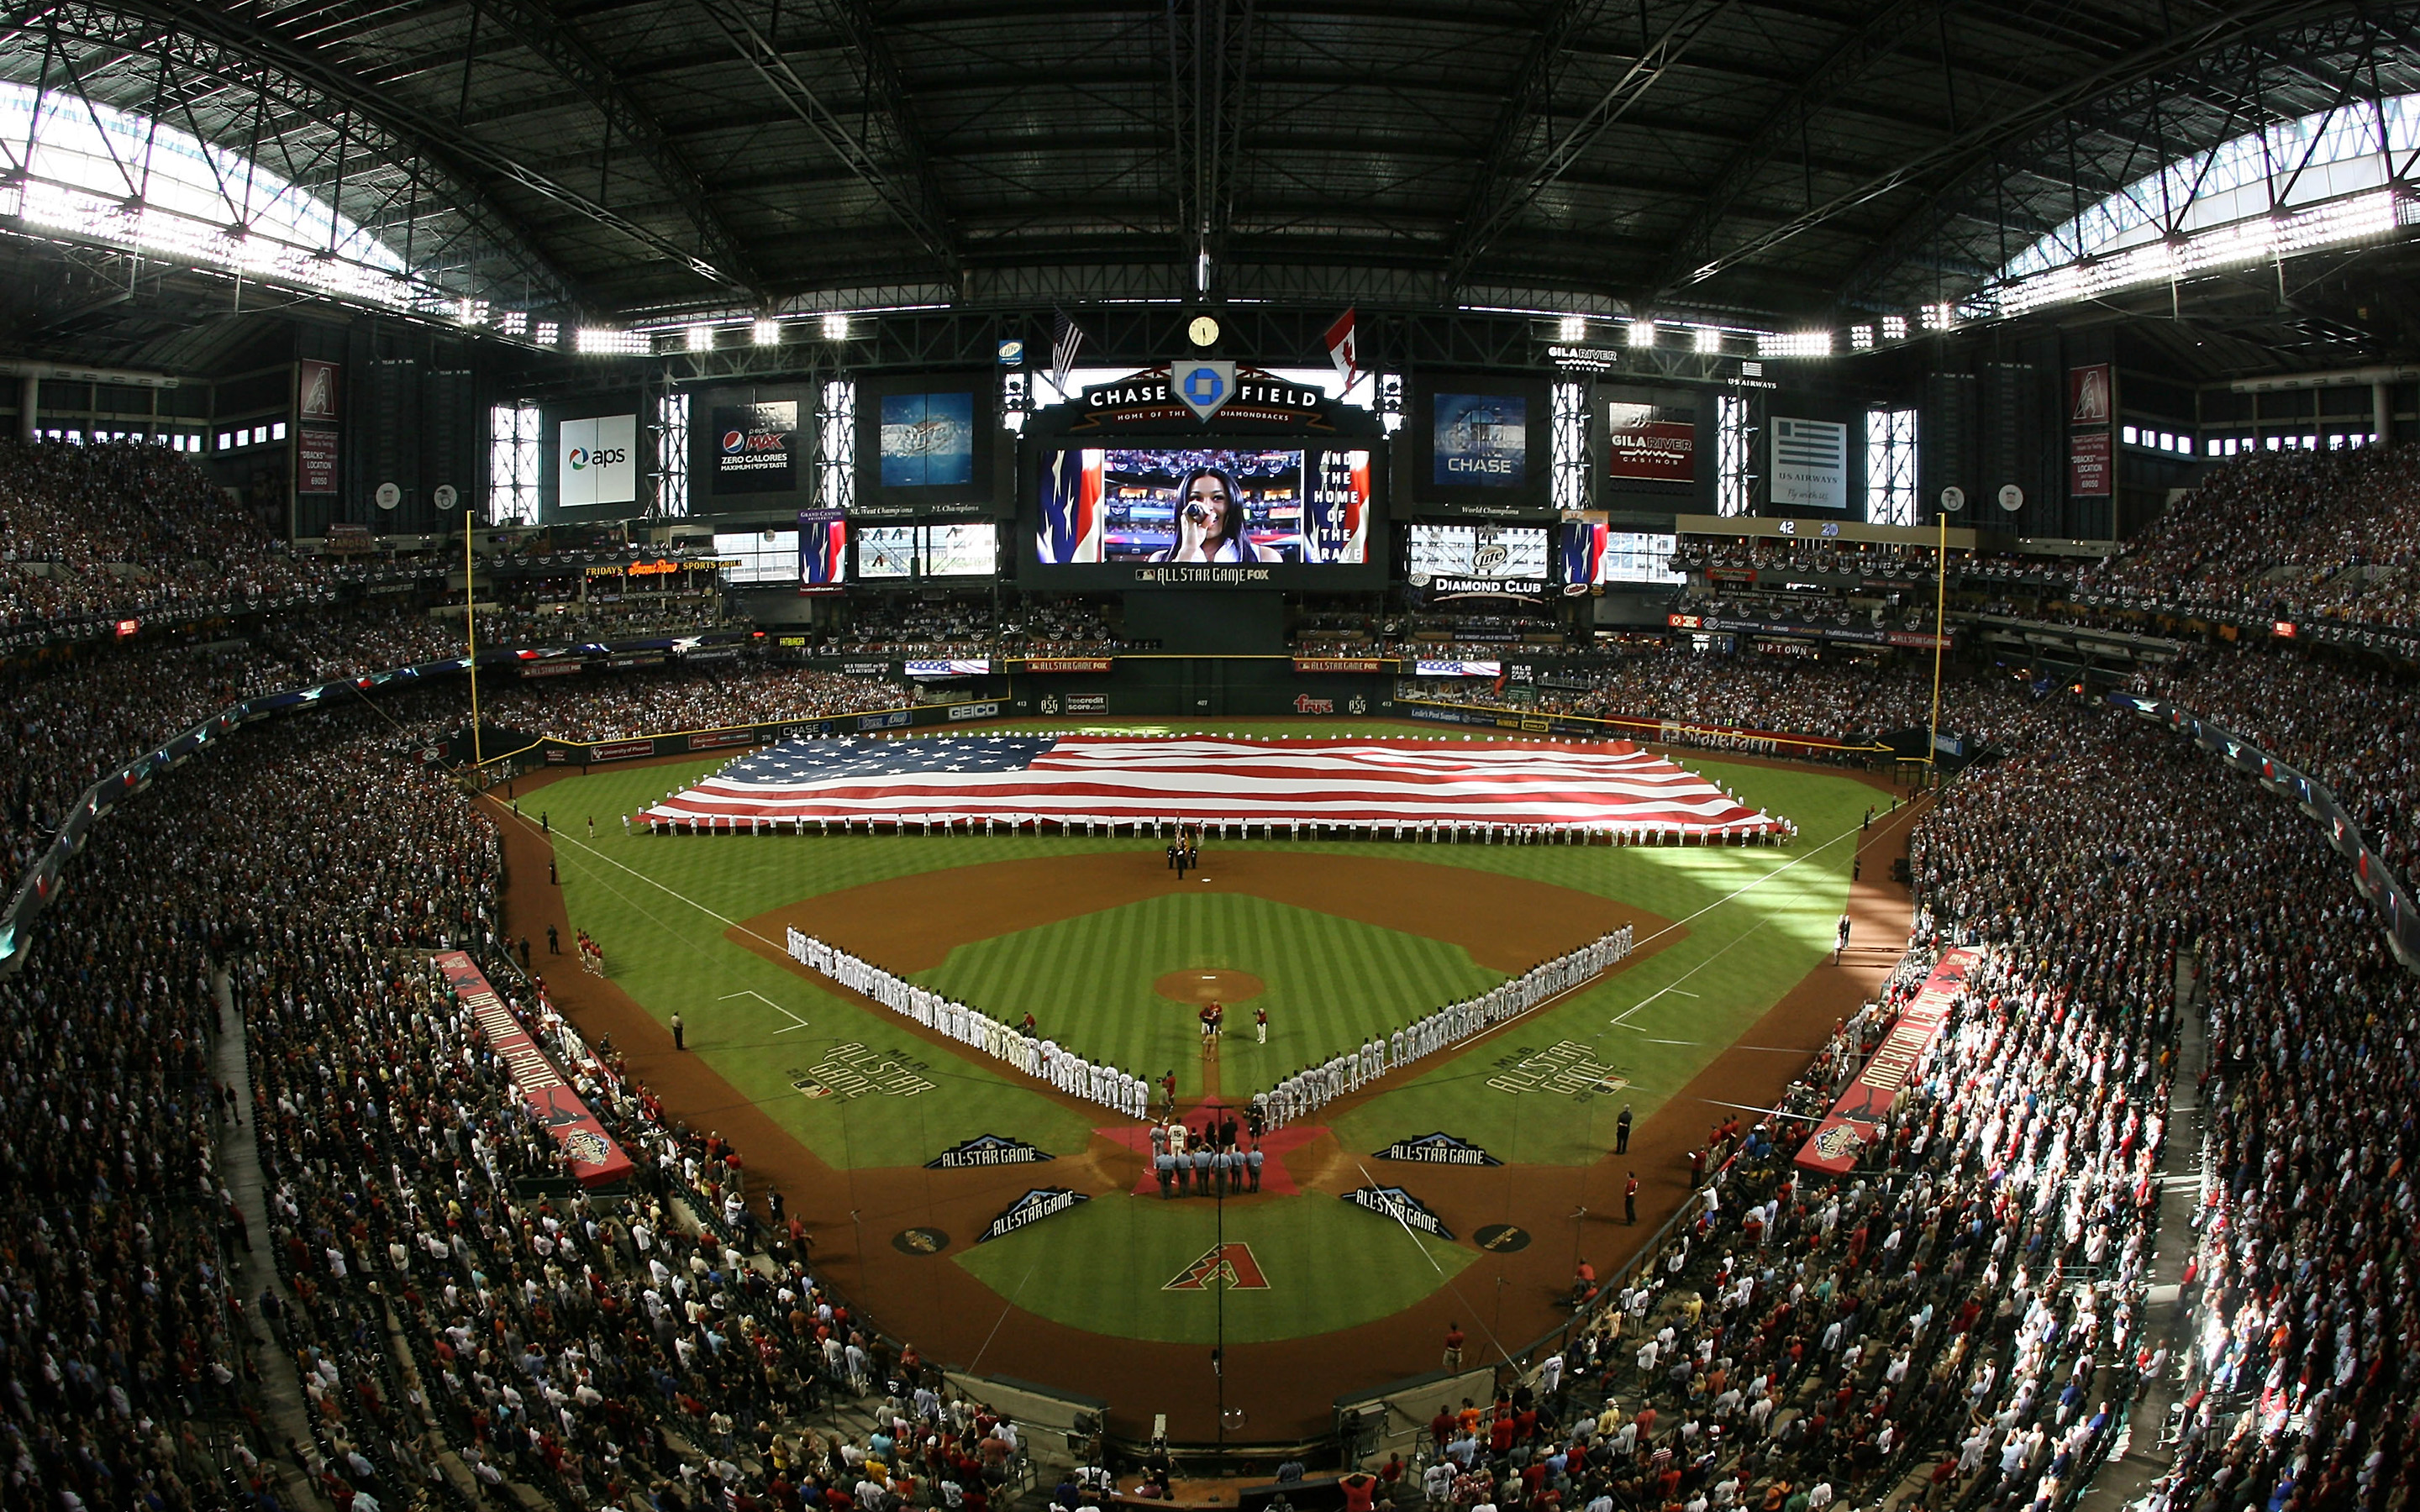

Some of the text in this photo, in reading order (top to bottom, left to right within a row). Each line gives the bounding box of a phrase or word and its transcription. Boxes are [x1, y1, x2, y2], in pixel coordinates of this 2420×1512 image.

[1549, 347, 1617, 361] GILA RIVER
[1741, 380, 1777, 389] AIRWAYS
[1090, 386, 1316, 407] CHASE FIELD
[1118, 412, 1144, 421] HOME
[1221, 411, 1289, 421] DIAMONDBACKS
[745, 433, 786, 451] MAX
[1612, 435, 1692, 451] GILA RIVER
[592, 448, 625, 469] aps
[721, 454, 787, 465] ZERO CALORIES
[1321, 452, 1351, 465] AND
[1623, 457, 1678, 465] CASINOS
[1449, 458, 1512, 474] CHASE
[1321, 472, 1351, 485] THE
[1780, 472, 1838, 484] US AIRWAYS
[1314, 491, 1359, 504] HOME
[1787, 488, 1797, 500] Fly
[1798, 490, 1818, 499] with
[877, 507, 913, 515] Champions
[942, 504, 979, 512] Champions
[1482, 507, 1519, 516] Champions
[1328, 510, 1346, 522] OF
[1778, 521, 1795, 534] 42
[1820, 522, 1839, 536] 20
[1321, 529, 1351, 542] THE
[1311, 548, 1361, 561] BRAVE
[586, 566, 623, 576] FRIDAYS
[628, 559, 677, 575] Front Row
[682, 561, 716, 570] SPORTS
[1157, 568, 1269, 586] ALL STAR GAME FOX
[1436, 578, 1541, 593] DIAMOND CLUB
[780, 637, 805, 646] FATBURGER
[1758, 643, 1807, 655] UPTOWN
[1054, 661, 1072, 669] STAR
[1073, 661, 1092, 669] GAME
[1311, 662, 1323, 670] ALL
[1325, 662, 1343, 670] STAR
[1344, 662, 1363, 670] GAME
[1041, 699, 1058, 712] ASG
[1294, 694, 1334, 714] fry's
[1349, 700, 1365, 712] ASG
[950, 706, 998, 719] GEICO
[889, 714, 906, 726] Dial
[783, 723, 819, 736] CHASE
[467, 991, 562, 1094] NATIONAL LEAGUE
[1860, 988, 1954, 1090] AMERICAN LEAGUE
[887, 1049, 930, 1071] MLB
[1491, 1047, 1534, 1070] MLB
[823, 1043, 939, 1097] ALL STAR
[1486, 1040, 1597, 1095] ALL STAR
[808, 1061, 883, 1099] GAME
[1540, 1058, 1615, 1095] GAME
[1001, 1147, 1036, 1163] GAME
[1449, 1149, 1485, 1164] GAME
[1044, 1190, 1074, 1215] GAME
[1407, 1208, 1439, 1234] GAME
